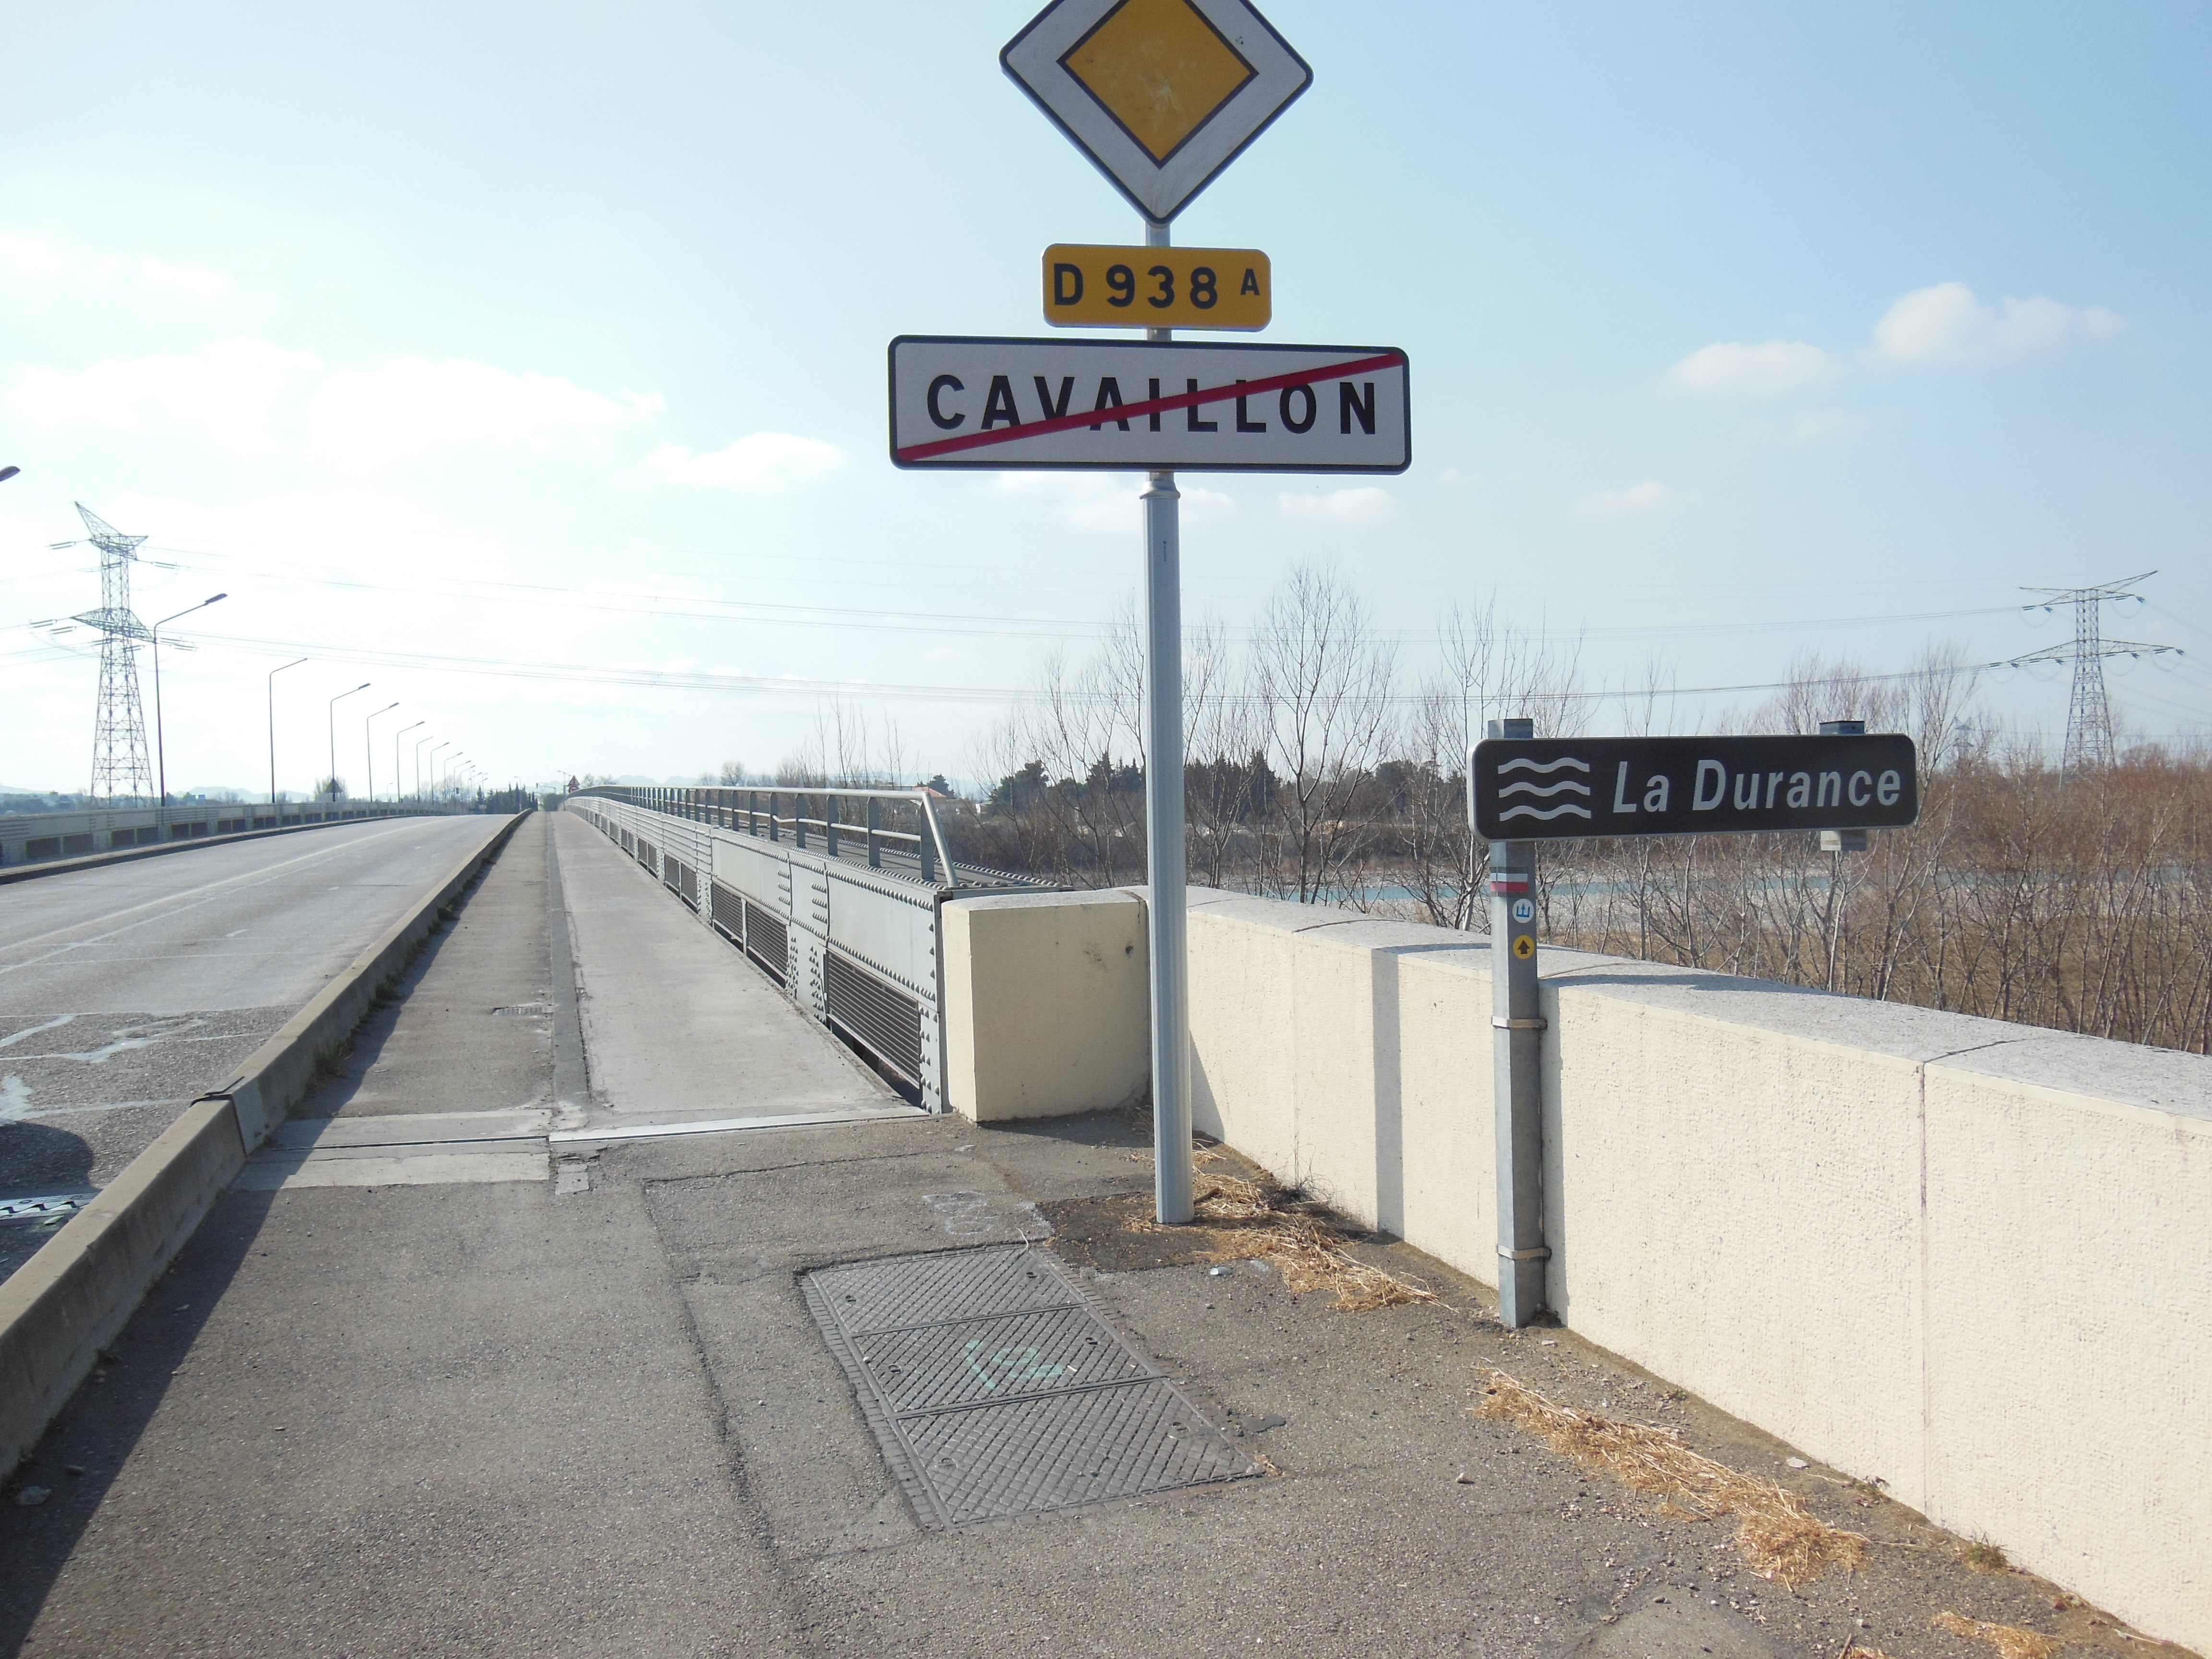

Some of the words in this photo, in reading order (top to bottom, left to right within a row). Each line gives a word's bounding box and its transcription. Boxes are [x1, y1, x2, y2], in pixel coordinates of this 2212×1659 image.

[1053, 263, 1084, 305] D
[1105, 264, 1218, 310] 938
[1240, 268, 1261, 296] A
[926, 374, 1376, 435] CAVAILLON
[1613, 761, 1669, 813] La
[1693, 759, 1901, 811] Durance
